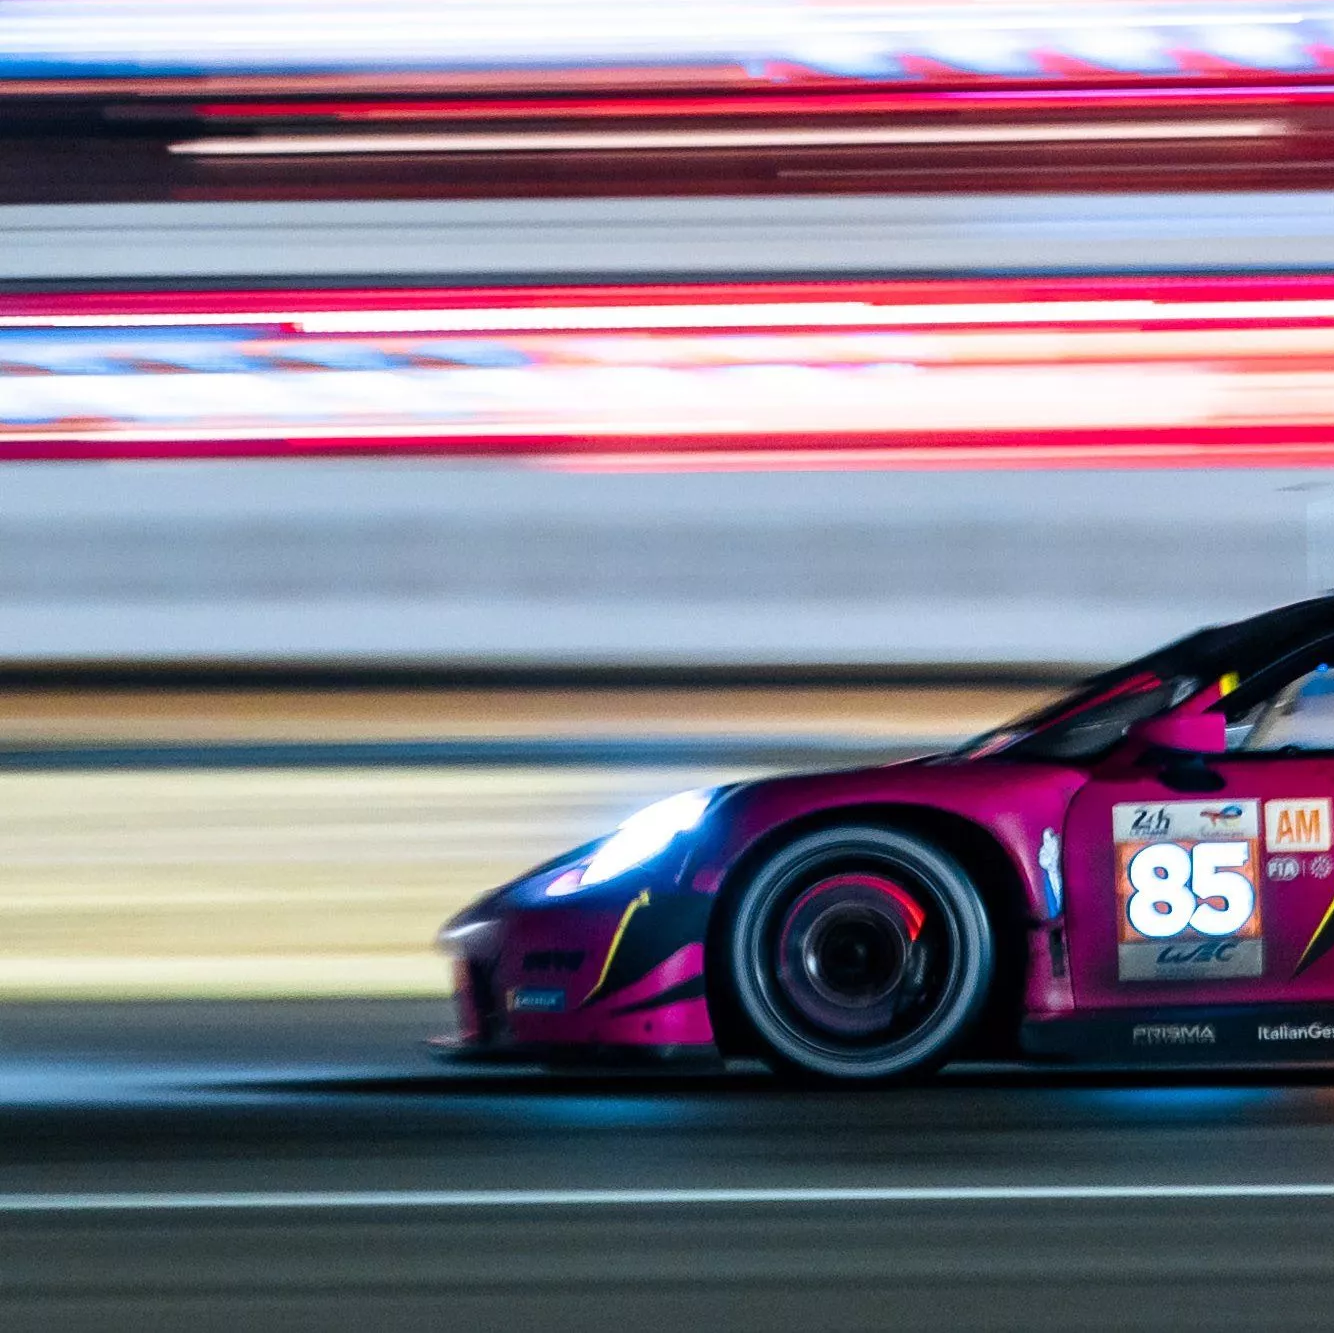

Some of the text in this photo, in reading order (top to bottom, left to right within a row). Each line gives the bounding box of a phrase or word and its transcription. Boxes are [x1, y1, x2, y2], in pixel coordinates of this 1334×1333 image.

[1275, 809, 1321, 843] AM
[1126, 840, 1256, 939] 85
[1132, 1023, 1216, 1044] PRISMA
